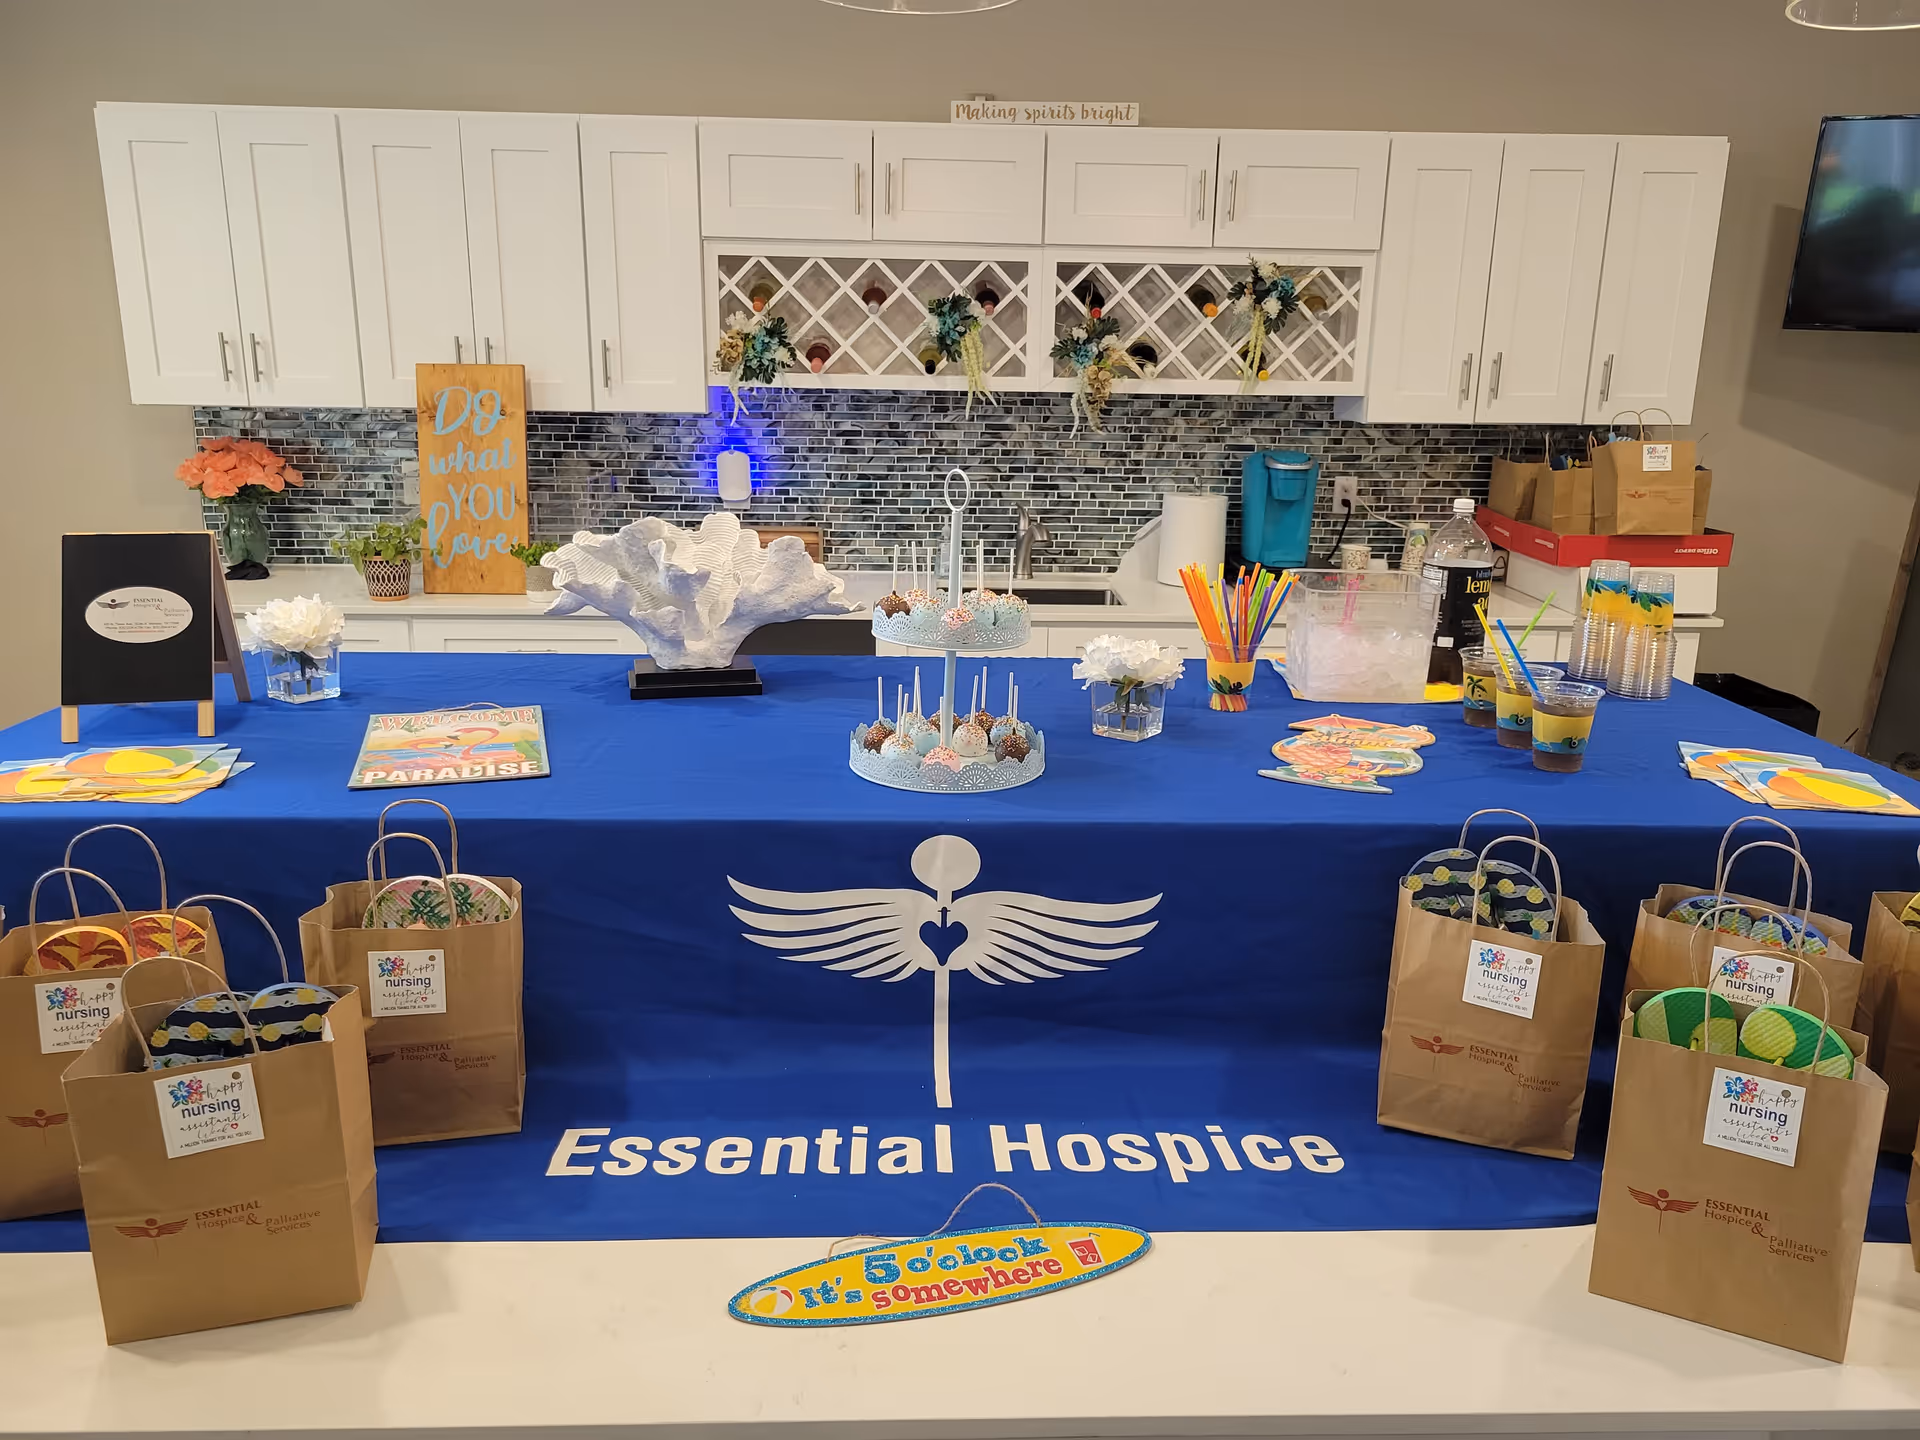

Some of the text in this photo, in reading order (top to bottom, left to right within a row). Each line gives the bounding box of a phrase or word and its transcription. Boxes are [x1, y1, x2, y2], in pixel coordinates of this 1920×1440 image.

[955, 103, 1135, 124] Making spirits bright
[432, 386, 505, 436] Do
[429, 437, 517, 475] what
[448, 482, 515, 520] YOU
[377, 708, 537, 731] WELCOME
[363, 761, 539, 784] PARADISE
[385, 975, 432, 988] nursing
[1482, 969, 1528, 989] nursing
[1749, 967, 1784, 983] happy
[80, 991, 117, 1006] happy
[1725, 979, 1775, 998] nursing
[56, 1005, 110, 1021] nursing
[400, 1043, 452, 1053] ESSENTIAL
[1469, 1045, 1519, 1063] ESSENTIAL
[1469, 1053, 1519, 1076] Hospice &
[206, 1080, 244, 1099] happy
[1758, 1089, 1799, 1108] happy
[181, 1098, 241, 1118] nursing
[1729, 1102, 1788, 1126] nursing
[1738, 1138, 1753, 1146] THANKS
[545, 1123, 1345, 1183] Essential Hospice
[195, 1200, 261, 1221] ESSENTIAL
[265, 1210, 321, 1227] Palliative
[1705, 1199, 1770, 1221] ESSENTIAL
[197, 1212, 264, 1229] Hospice &
[266, 1221, 311, 1235] Services
[1705, 1209, 1768, 1239] Hospice &
[1768, 1245, 1815, 1262] Services
[1770, 1236, 1829, 1257] Palliative
[799, 1276, 863, 1310] It's
[864, 1253, 901, 1284] 5
[871, 1257, 1063, 1310] somewhere
